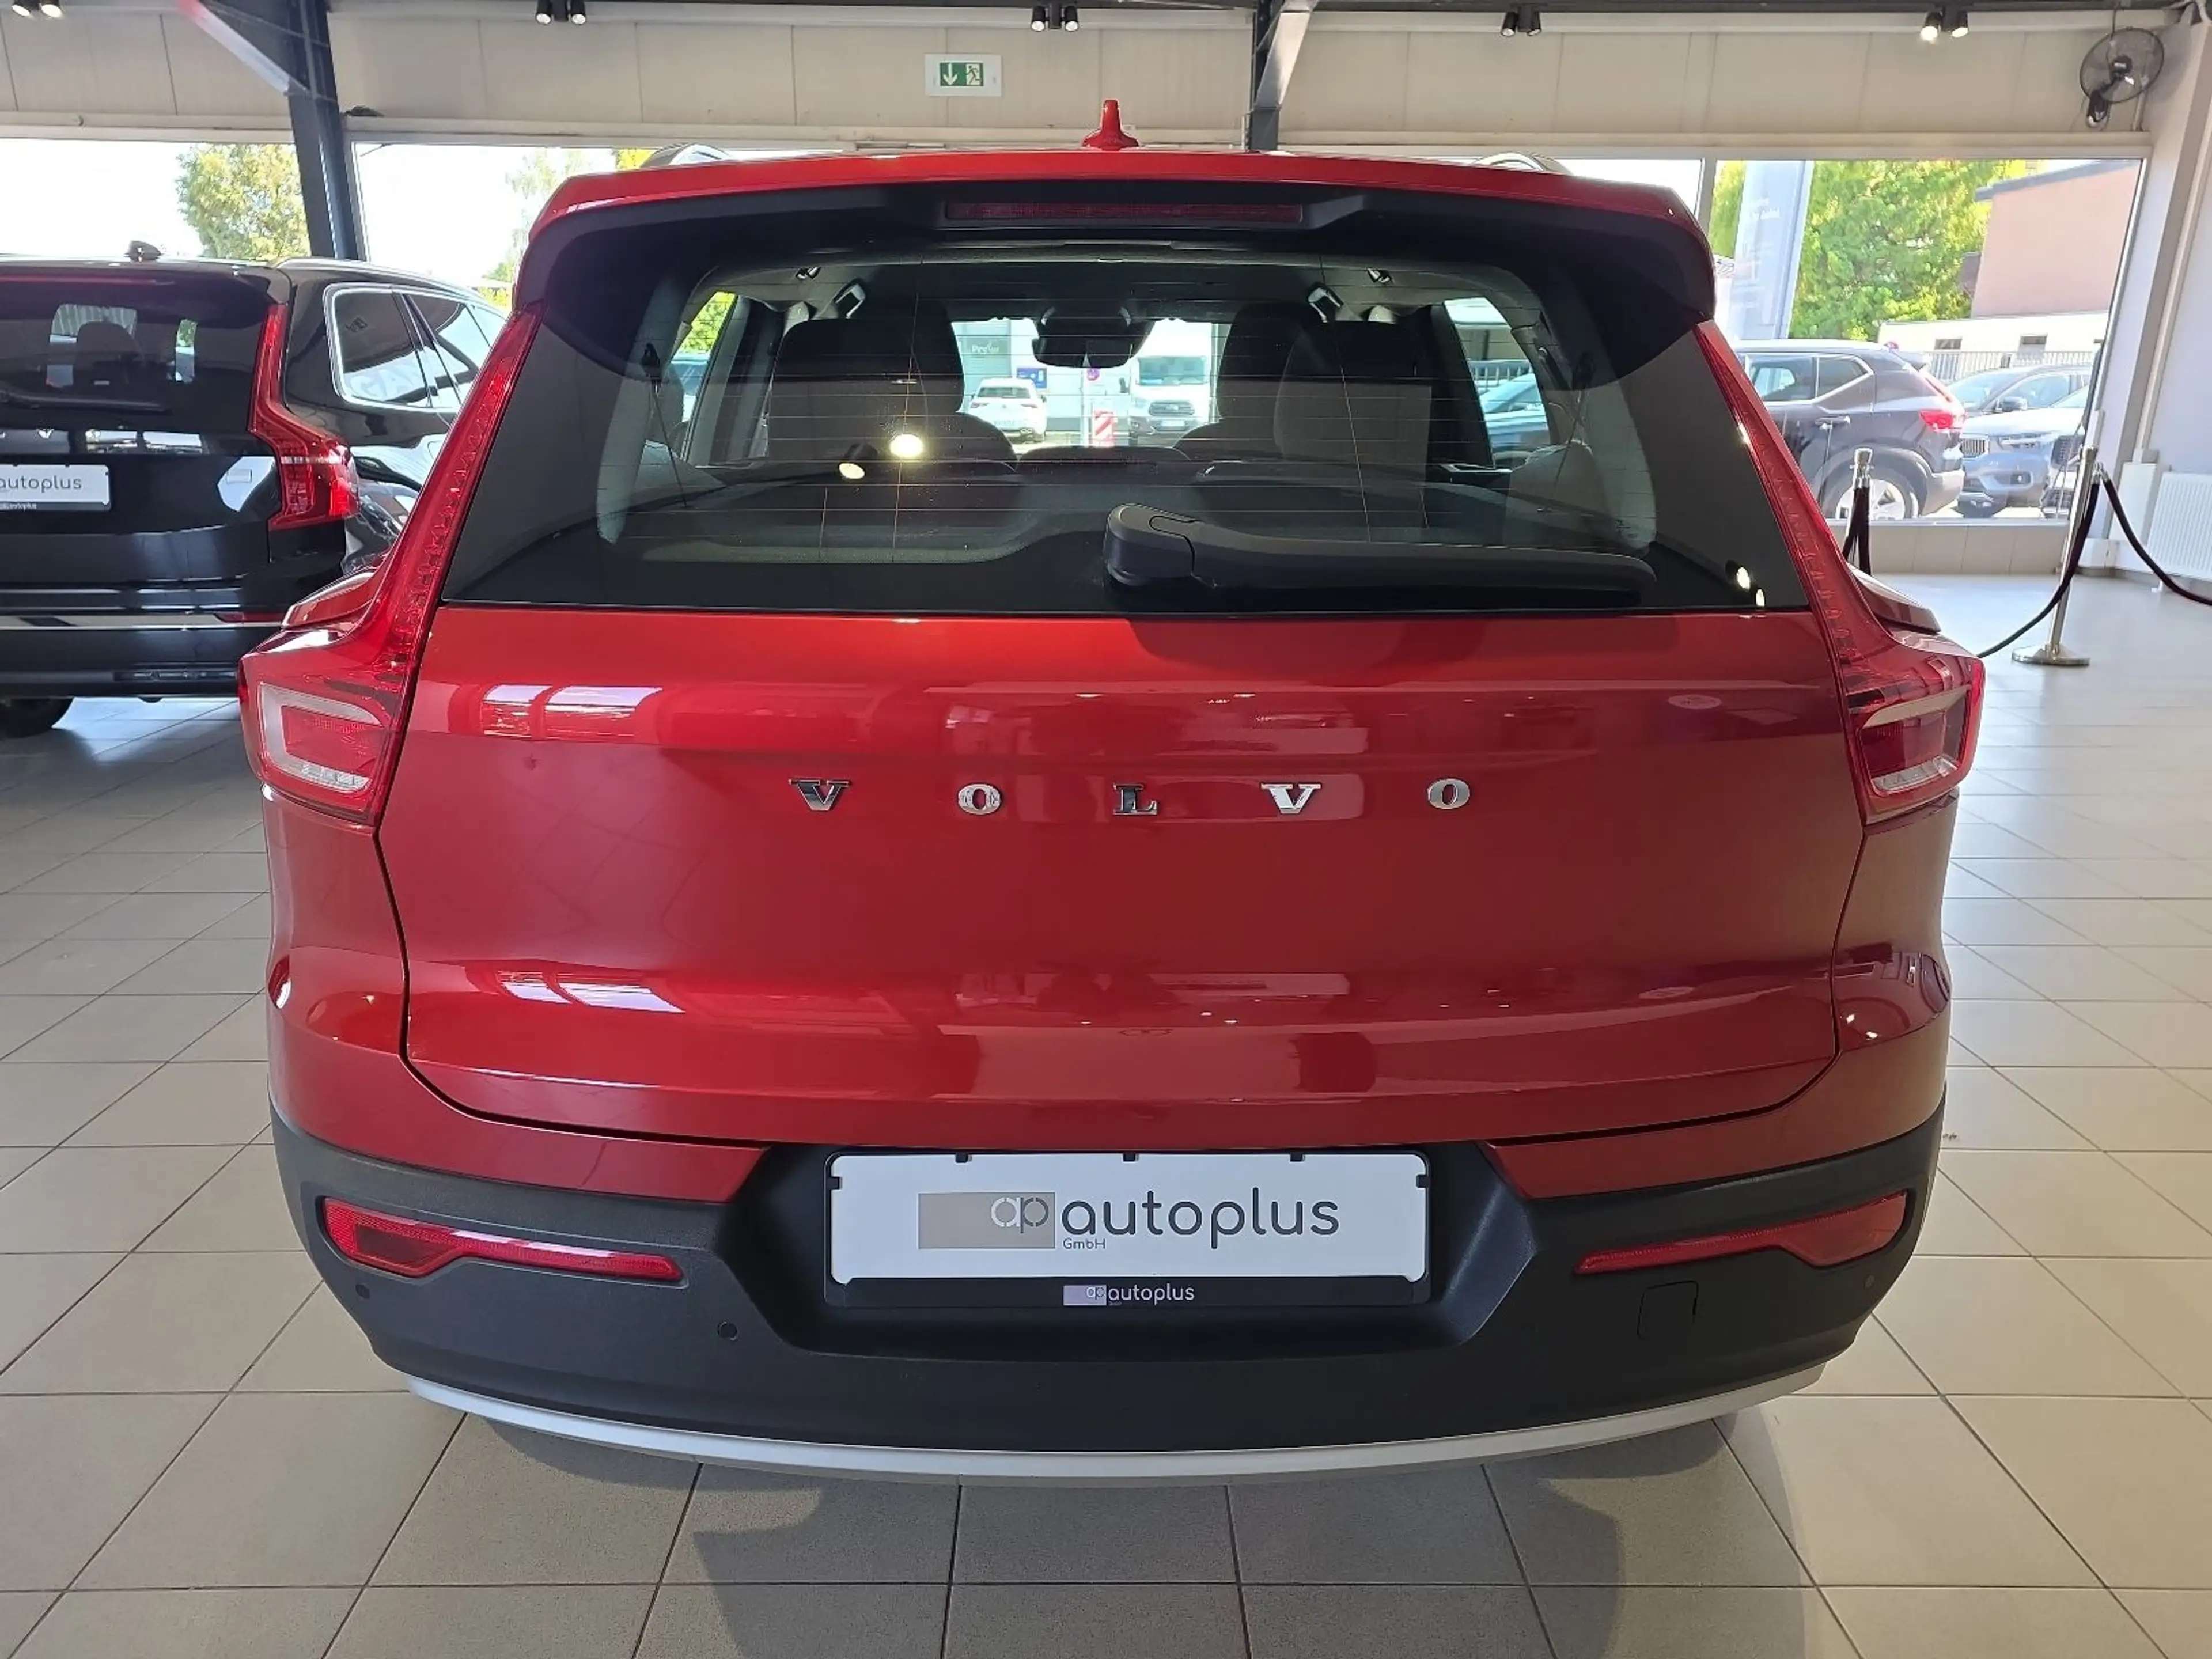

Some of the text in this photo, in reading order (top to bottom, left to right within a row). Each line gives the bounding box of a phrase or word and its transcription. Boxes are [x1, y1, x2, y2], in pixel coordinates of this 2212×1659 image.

[789, 778, 1471, 816] VOLVO
[1062, 1187, 1339, 1249] autoplus
[1063, 1238, 1105, 1249] GmbH
[1108, 1283, 1195, 1306] autoplus
